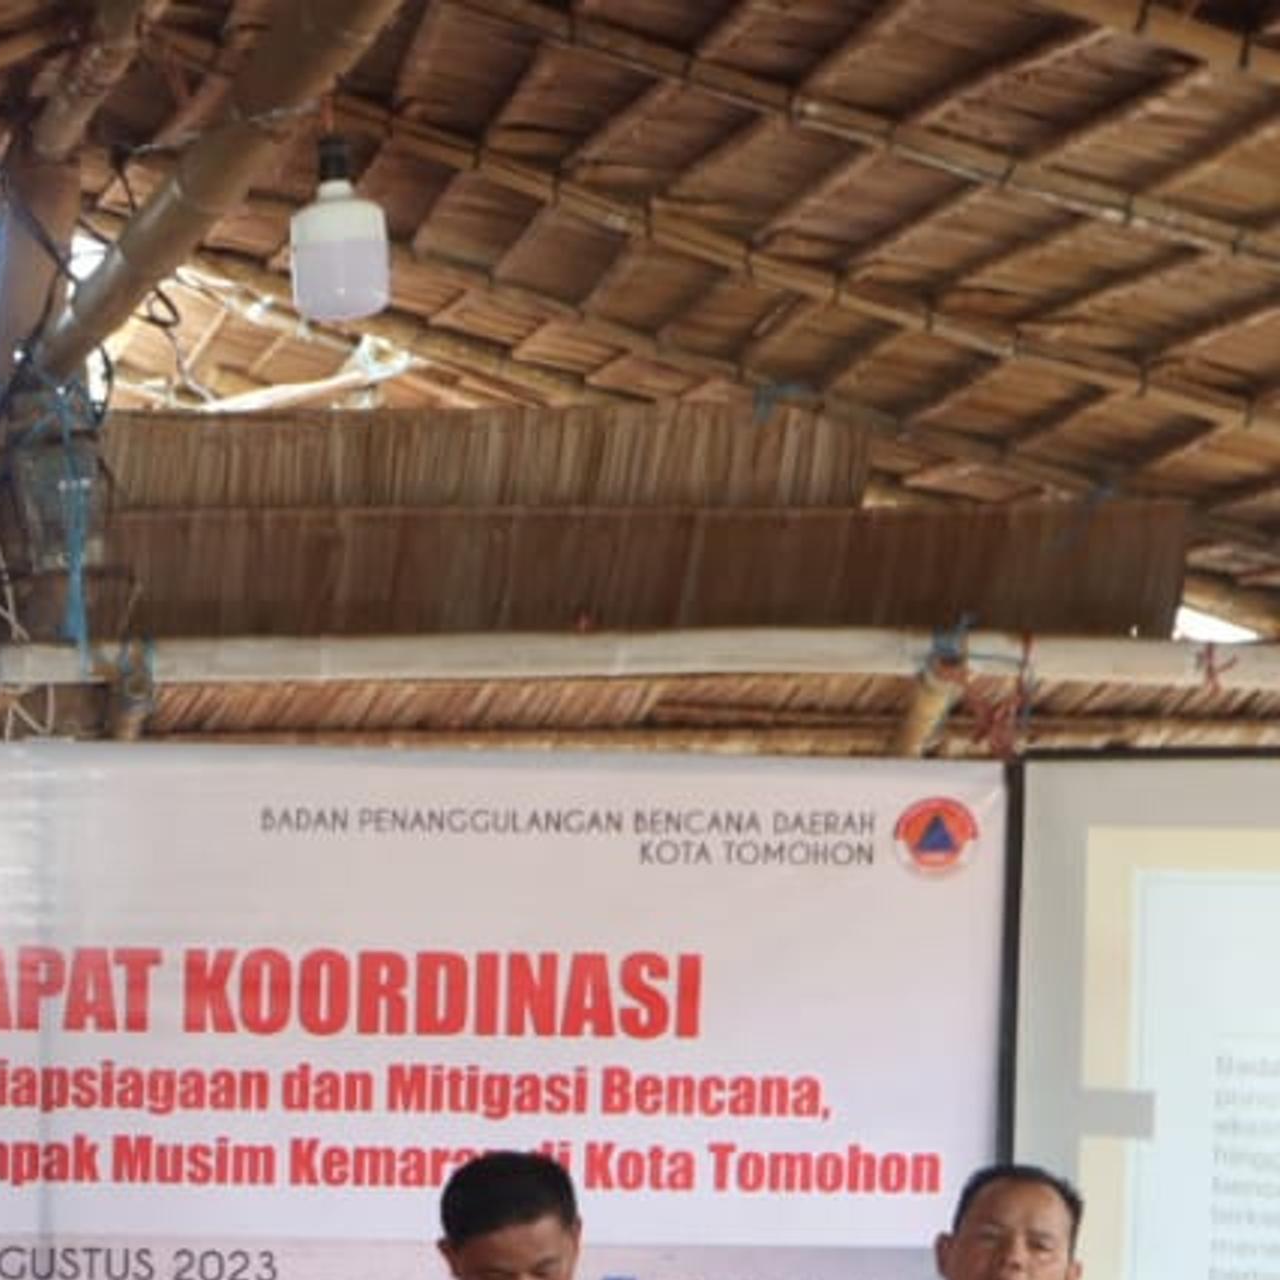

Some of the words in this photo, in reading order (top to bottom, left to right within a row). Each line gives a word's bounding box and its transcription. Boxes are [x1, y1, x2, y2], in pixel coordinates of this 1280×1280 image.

[261, 809, 349, 833] BADAN
[359, 809, 623, 835] PENANGGULANGAN
[634, 811, 759, 836] BENCANA
[772, 812, 875, 836] DAERAH
[640, 841, 713, 866] KOTA
[723, 841, 874, 867] TOMOHON
[183, 947, 702, 1039] KOORDINASI
[282, 1064, 372, 1112] dan
[387, 1065, 587, 1121] Mitigasi
[601, 1066, 830, 1122] Bencana,
[112, 1135, 275, 1186] Musim
[289, 1138, 478, 1188] Kemar
[585, 1143, 695, 1191] Kota
[708, 1144, 941, 1194] Tomohon
